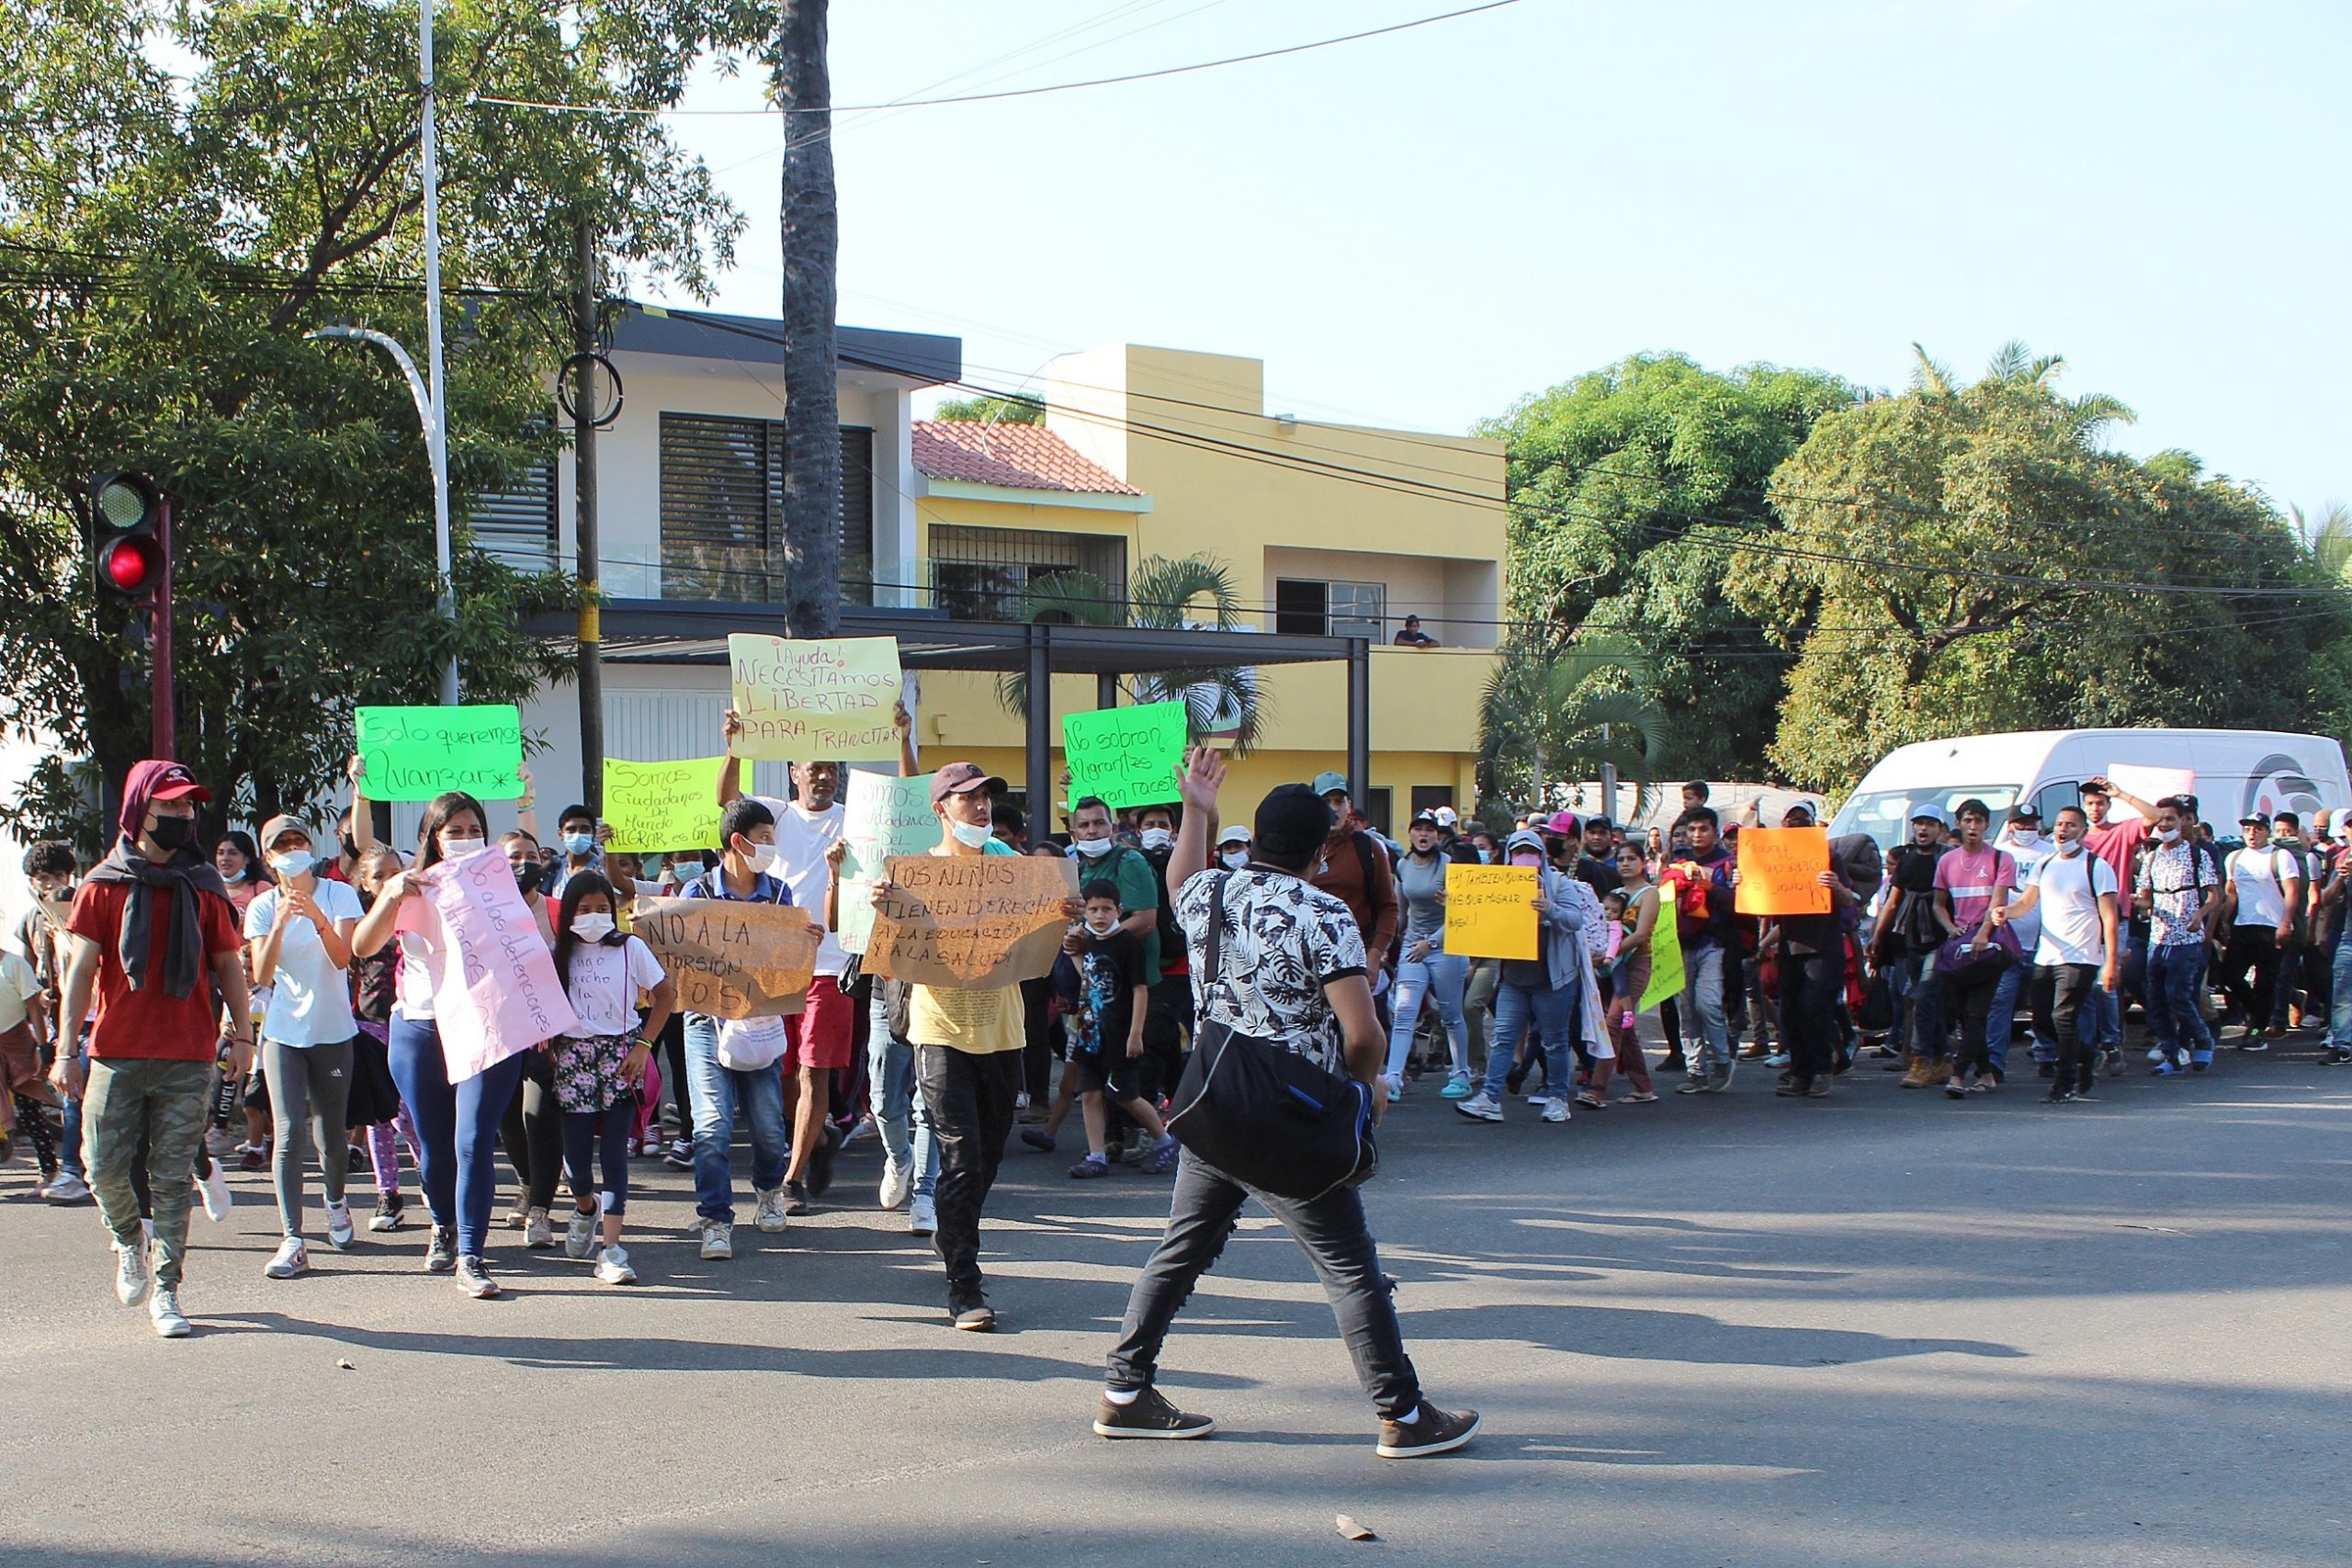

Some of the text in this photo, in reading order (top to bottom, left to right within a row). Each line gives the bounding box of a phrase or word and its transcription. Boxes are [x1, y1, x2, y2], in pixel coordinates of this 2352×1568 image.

[363, 716, 521, 754] Solo queremos
[737, 718, 806, 742] PARA
[1064, 716, 1166, 753] No sobran
[612, 787, 703, 807] Ciudadanos
[625, 814, 674, 832] Mundo
[645, 806, 669, 818] Del
[672, 833, 688, 843] es
[889, 862, 1015, 890] LOS NIÑOS
[879, 893, 1062, 919] TIENEN DERECHO
[648, 910, 751, 946] NO A LA
[877, 924, 890, 940] A
[896, 926, 918, 941] LA
[873, 942, 882, 957] Y
[891, 944, 902, 959] A
[907, 945, 930, 961] LA
[500, 933, 551, 1034] detenciones
[577, 1004, 613, 1021] alud
